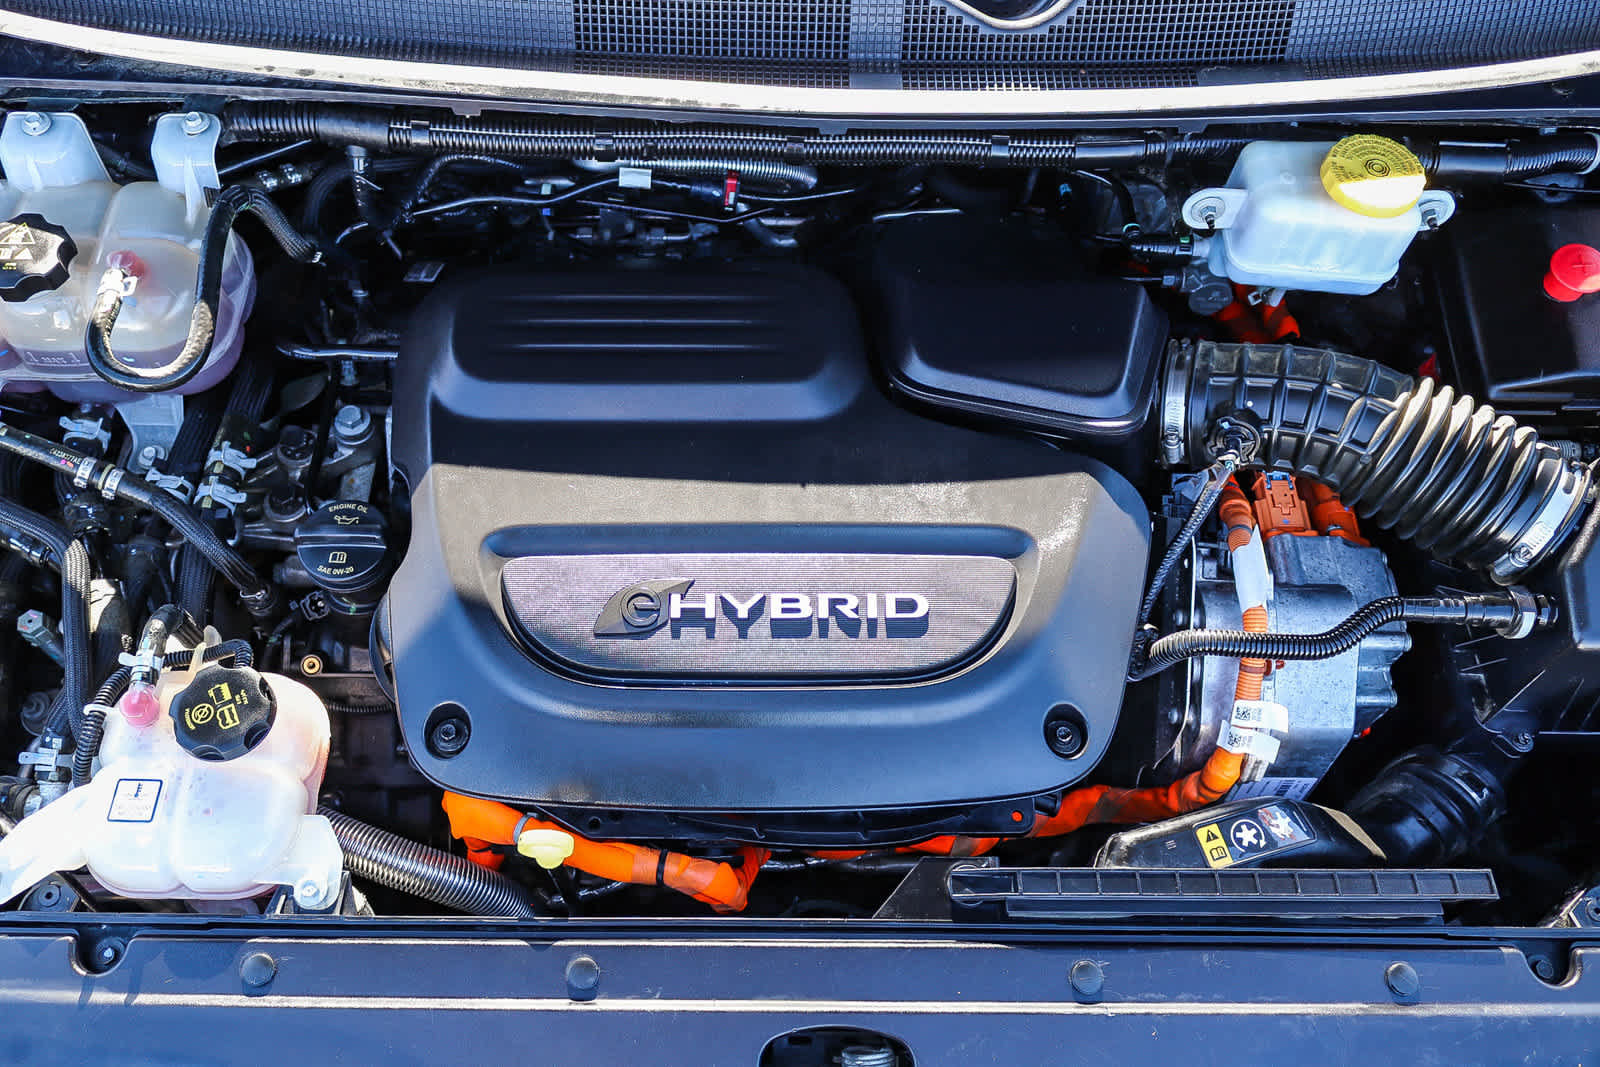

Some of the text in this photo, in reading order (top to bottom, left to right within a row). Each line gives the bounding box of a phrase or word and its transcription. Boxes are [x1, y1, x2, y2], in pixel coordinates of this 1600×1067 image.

[328, 503, 368, 514] ENGINE OIL
[317, 565, 354, 575] SAE 0W-20
